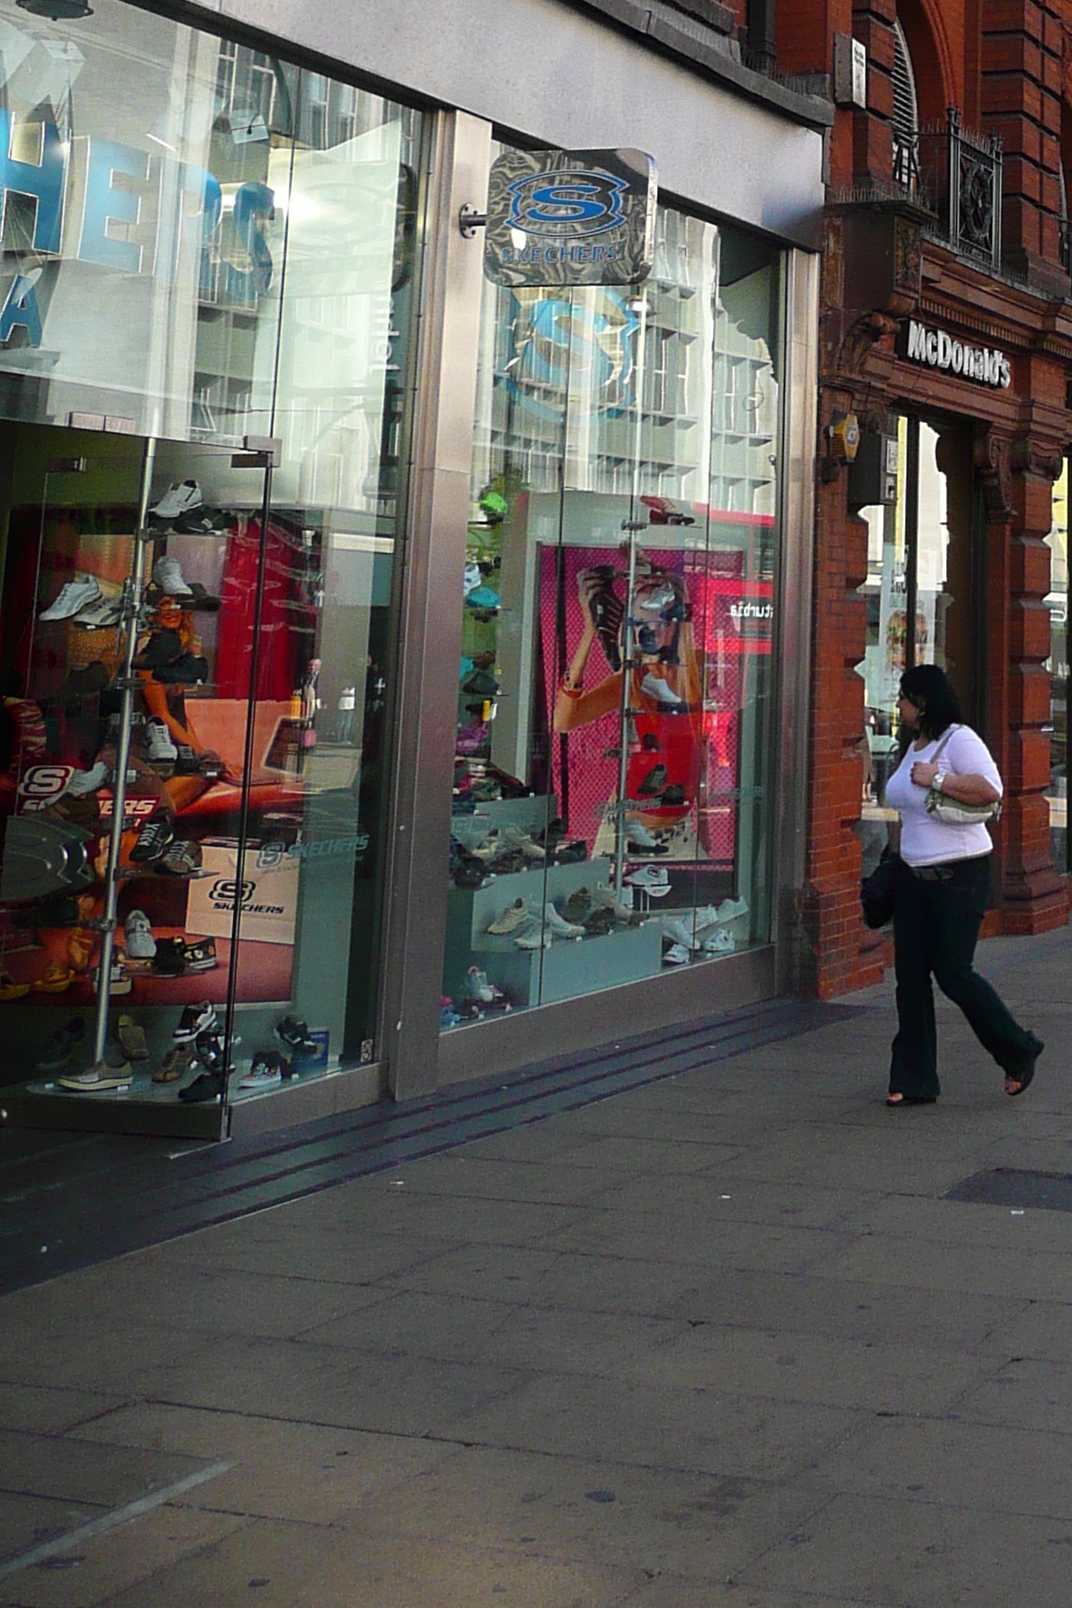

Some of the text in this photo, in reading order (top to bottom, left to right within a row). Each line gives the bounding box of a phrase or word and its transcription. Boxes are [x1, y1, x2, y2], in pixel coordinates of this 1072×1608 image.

[502, 245, 619, 264] SKECHERS
[907, 320, 1012, 389] McDonald's
[287, 835, 370, 860] SKECHERS
[213, 902, 285, 915] SKCHERS
